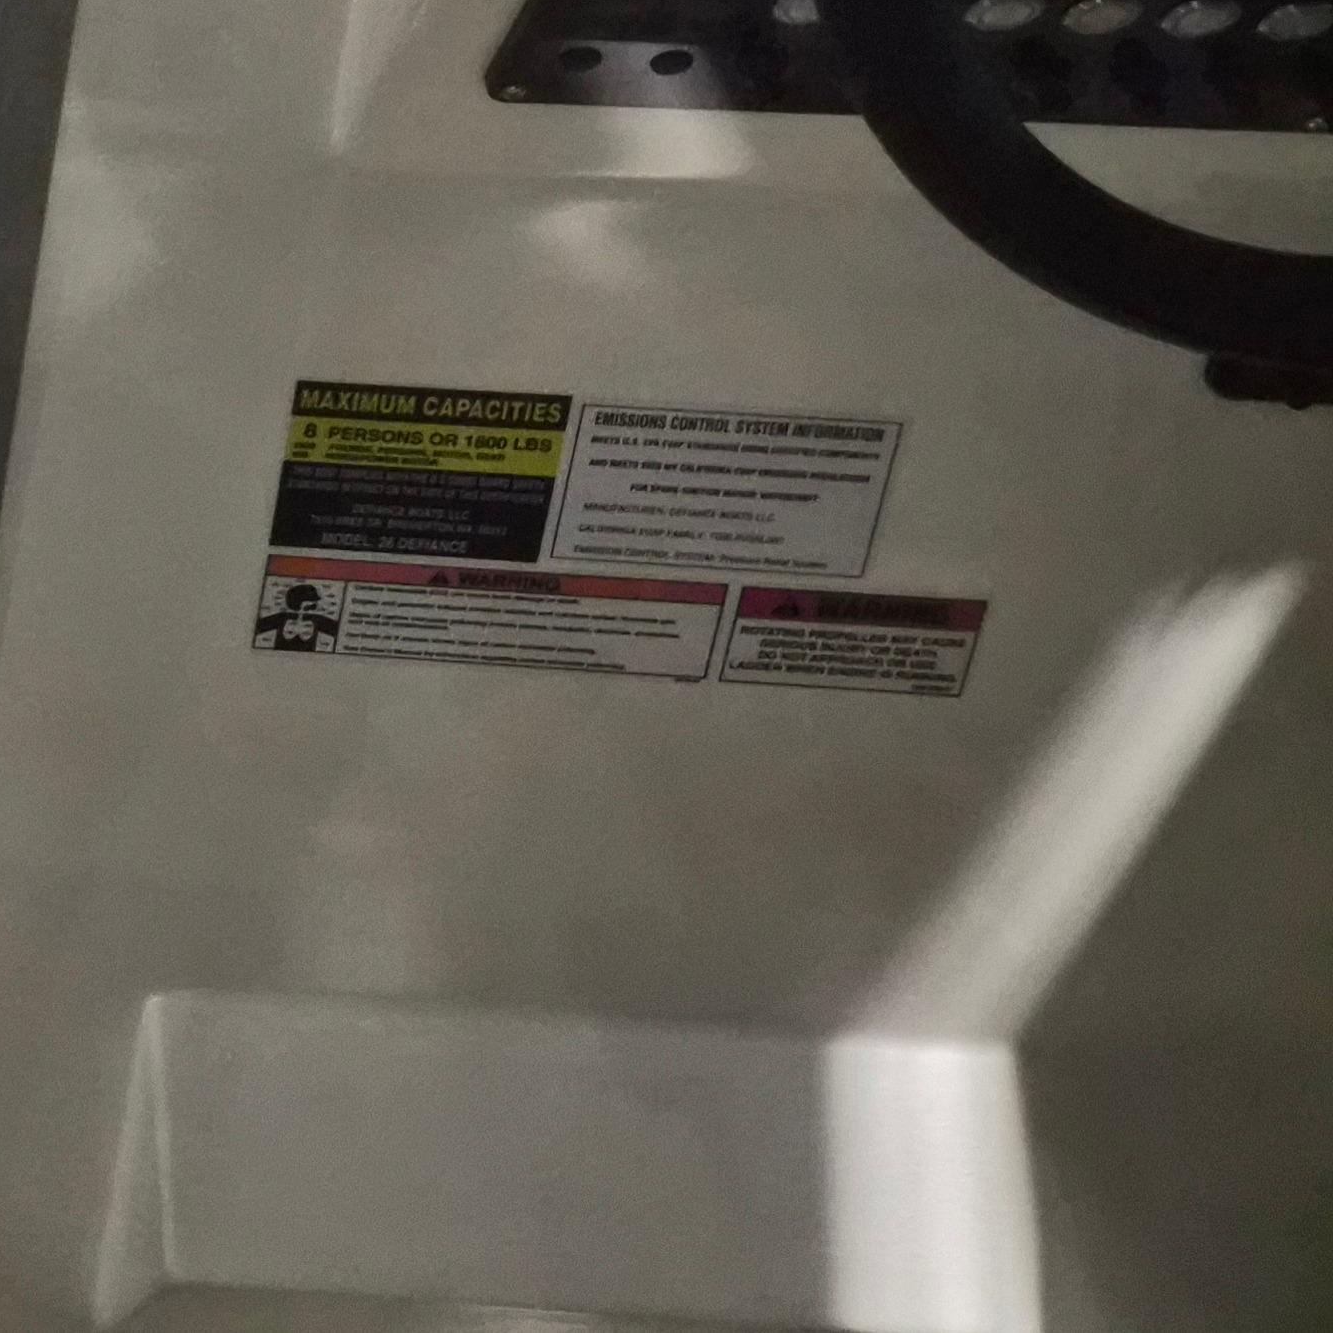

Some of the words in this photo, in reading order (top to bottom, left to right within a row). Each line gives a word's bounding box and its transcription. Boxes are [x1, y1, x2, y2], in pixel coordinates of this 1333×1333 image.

[299, 388, 418, 415] MAXIMUM
[422, 396, 563, 424] CAPACITIES
[327, 425, 425, 446] PERSONS
[429, 431, 459, 449] OR
[512, 436, 553, 454] LBS
[593, 411, 668, 430] EMISSIONS
[669, 415, 730, 434] CONTROL
[733, 419, 791, 437] SYSTEM
[791, 423, 885, 443] INFORMATION
[457, 571, 562, 593] WARNING
